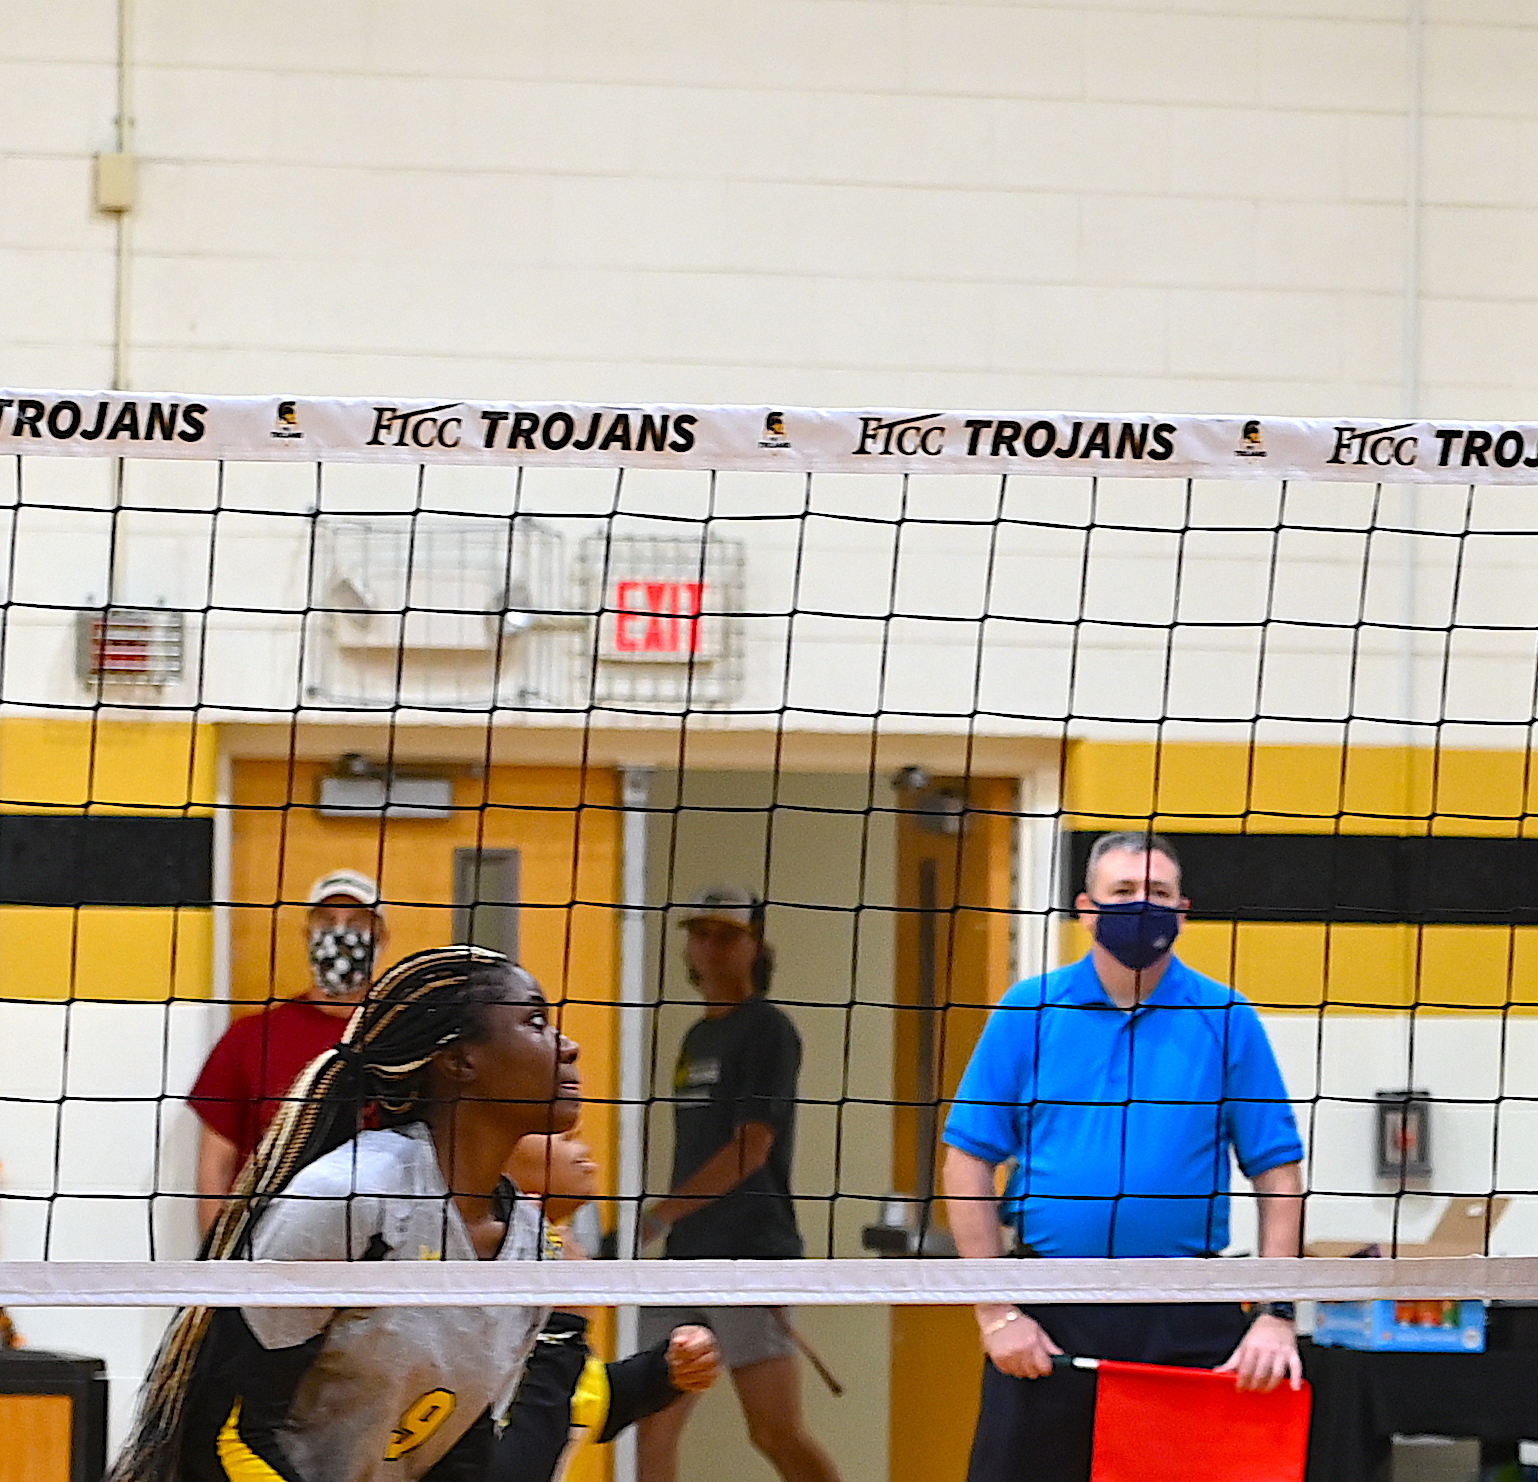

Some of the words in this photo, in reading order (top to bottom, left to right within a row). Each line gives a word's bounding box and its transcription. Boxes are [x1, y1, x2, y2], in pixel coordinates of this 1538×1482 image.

[481, 410, 699, 453] TROJANS
[964, 419, 1177, 461] TROJANS
[615, 582, 709, 653] EXIT
[382, 1386, 458, 1461] 9
